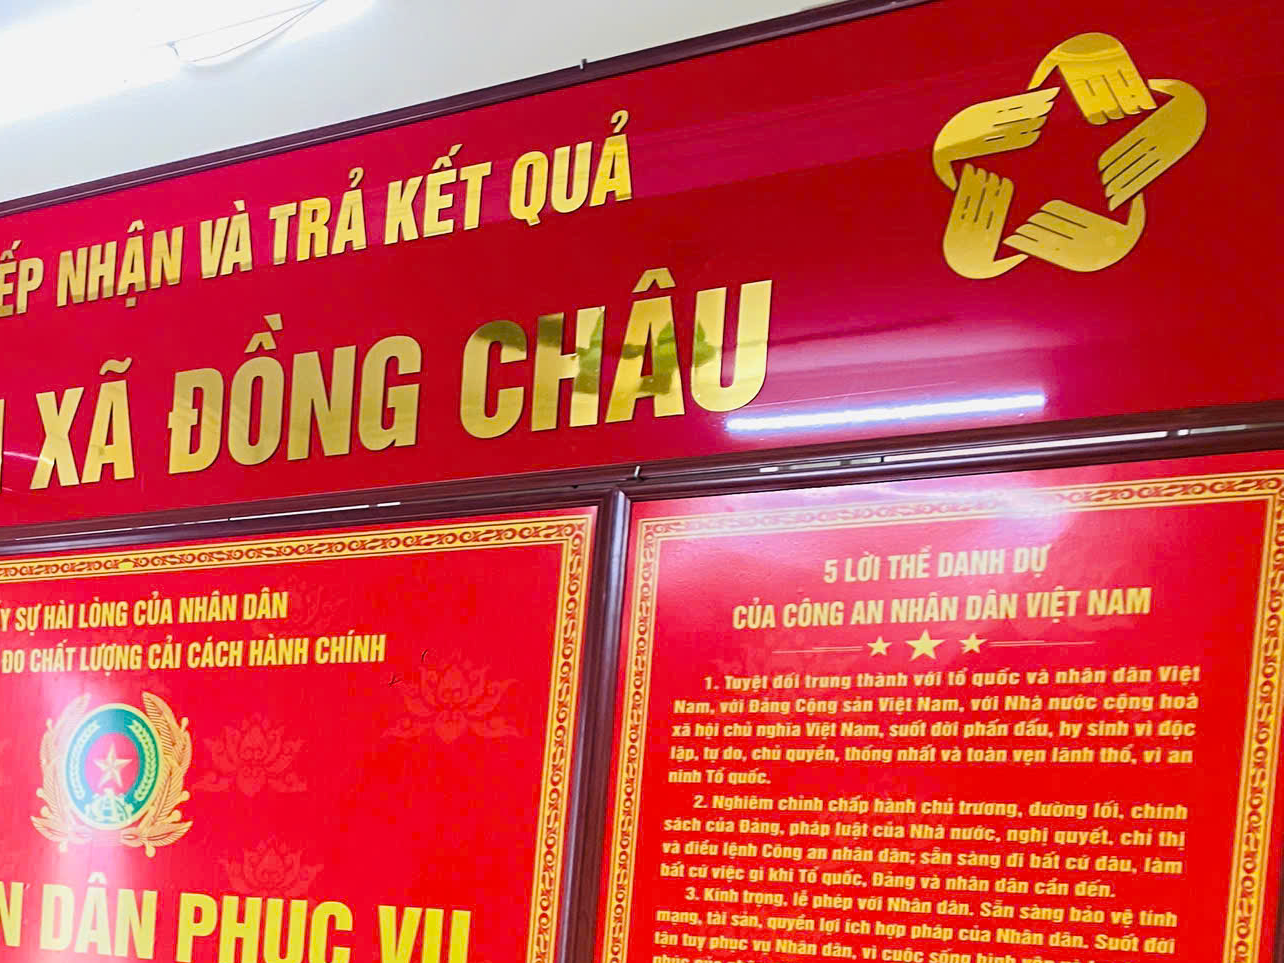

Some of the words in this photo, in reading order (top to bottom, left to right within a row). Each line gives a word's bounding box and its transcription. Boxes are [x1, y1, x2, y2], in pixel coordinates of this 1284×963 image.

[56, 219, 184, 307] NHẬN
[199, 200, 252, 278] VÀ
[270, 167, 366, 264] TRẢ
[384, 144, 491, 245] KẾT
[510, 110, 632, 225] QUẢ
[30, 357, 134, 490] XÃ
[168, 314, 422, 475] ĐỒNG
[459, 267, 772, 440] CHÂU
[821, 557, 839, 584] 5
[843, 551, 881, 584] LỜI
[936, 547, 1006, 576] DANH
[1011, 543, 1050, 576] DỰ
[14, 600, 40, 632] SỰ
[42, 598, 75, 630] HÀI
[77, 597, 129, 629] LÒNG
[132, 594, 173, 627] CỦA
[178, 591, 238, 624] NHÂN
[241, 588, 289, 619] DÂN
[731, 600, 776, 632] CỦA
[781, 597, 845, 629] CÔNG
[851, 597, 885, 624] AN
[889, 589, 959, 624] NHÂN
[964, 589, 1019, 621] DÂN
[1025, 584, 1078, 620] VIỆT
[1086, 583, 1153, 616] NAM
[0, 645, 26, 672] ĐO
[28, 640, 75, 672] CHẤT
[79, 641, 144, 674] LƯỢNG
[145, 636, 183, 672] CẢI
[186, 636, 244, 672] CÁCH
[247, 633, 309, 667] HÀNH
[313, 631, 387, 664] CHÍNH
[41, 872, 156, 957] DÂN
